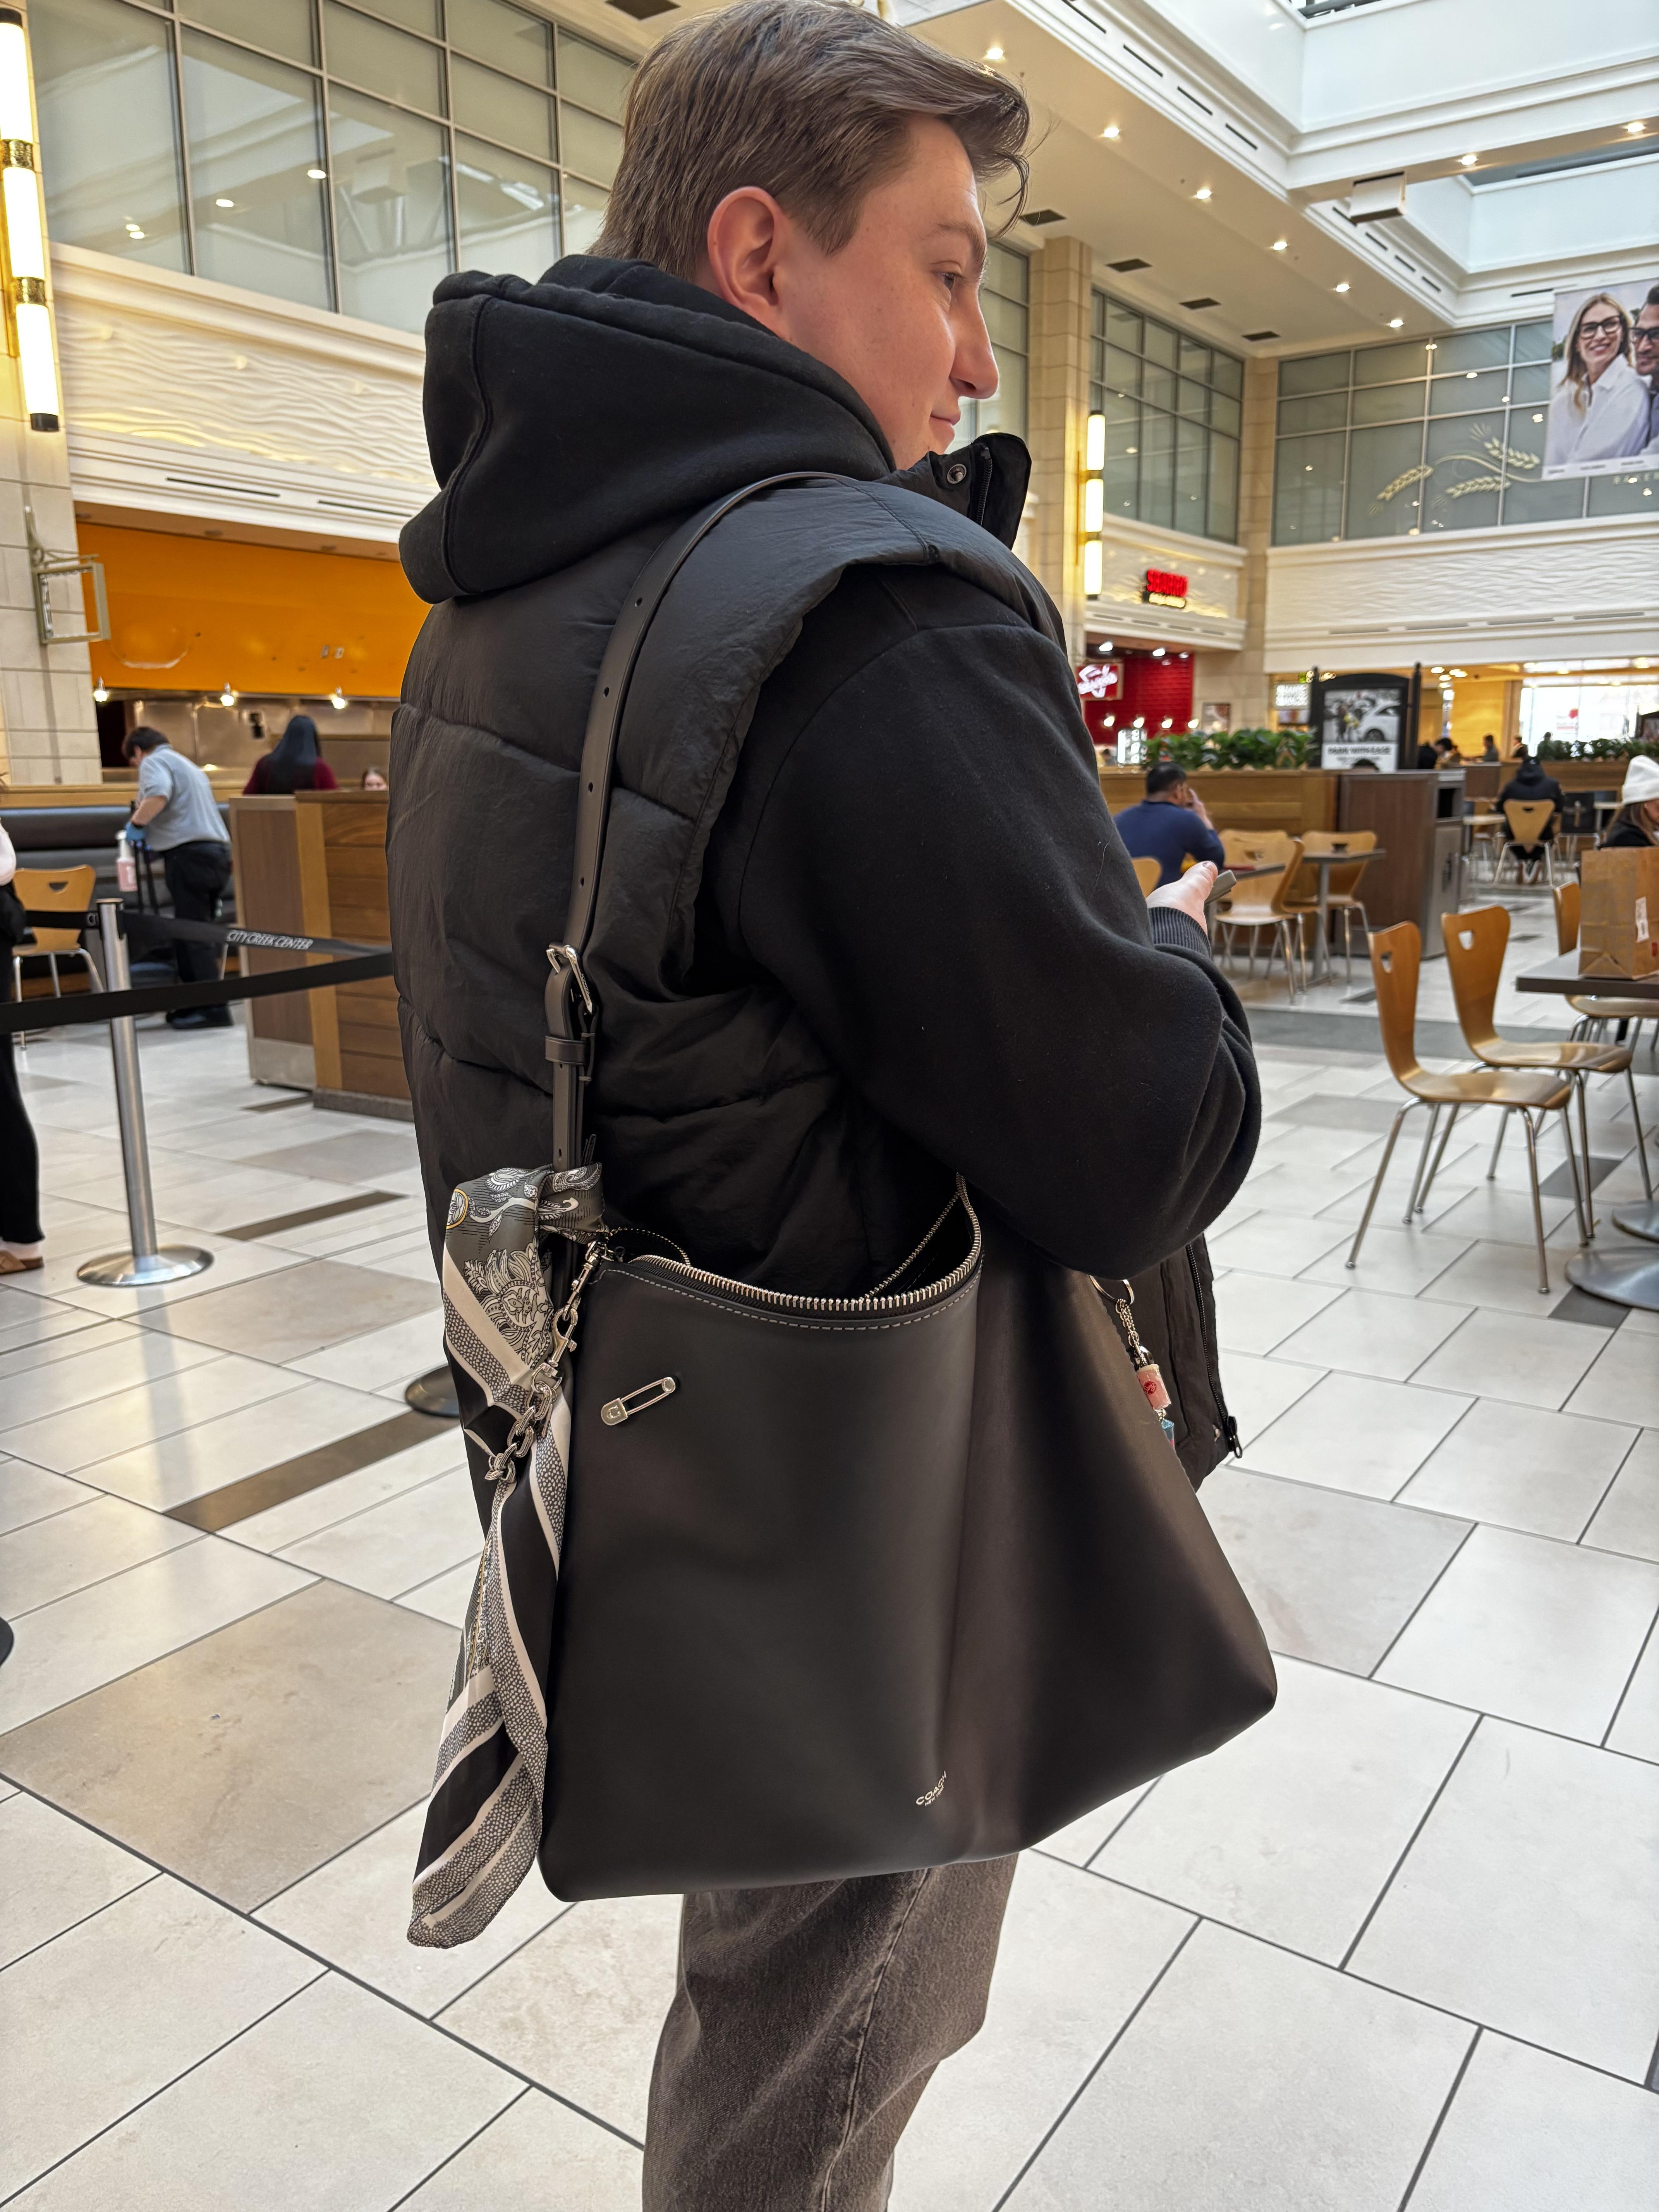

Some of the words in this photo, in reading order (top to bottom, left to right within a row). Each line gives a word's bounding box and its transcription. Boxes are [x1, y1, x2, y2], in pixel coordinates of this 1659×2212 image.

[227, 929, 247, 943] CITY
[246, 932, 275, 946] CREEK
[273, 935, 313, 950] CENTER
[915, 1770, 947, 1805] COACH
